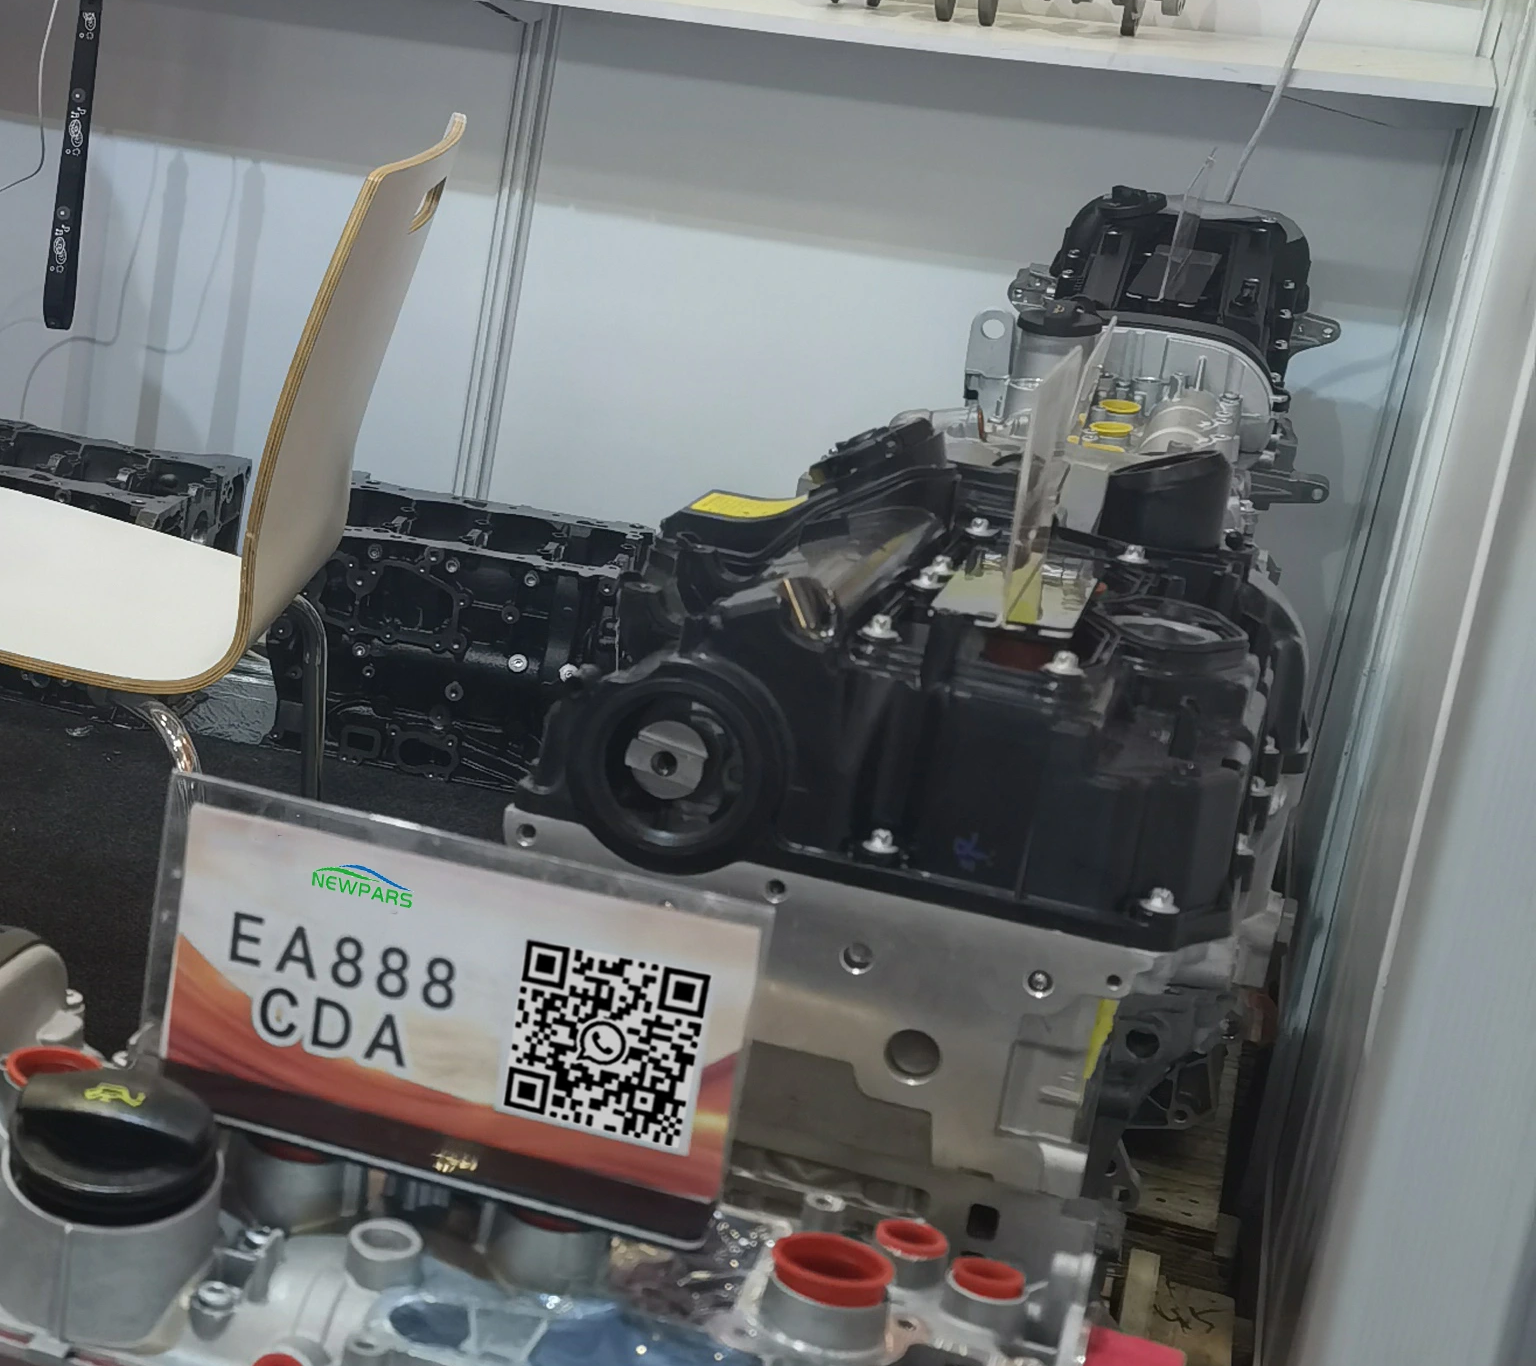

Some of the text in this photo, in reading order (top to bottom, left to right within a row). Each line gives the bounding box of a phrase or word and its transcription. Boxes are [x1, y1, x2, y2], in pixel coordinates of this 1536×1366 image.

[311, 871, 413, 909] NEWPARS
[228, 912, 456, 1010] EA888
[260, 988, 406, 1068] CDA
